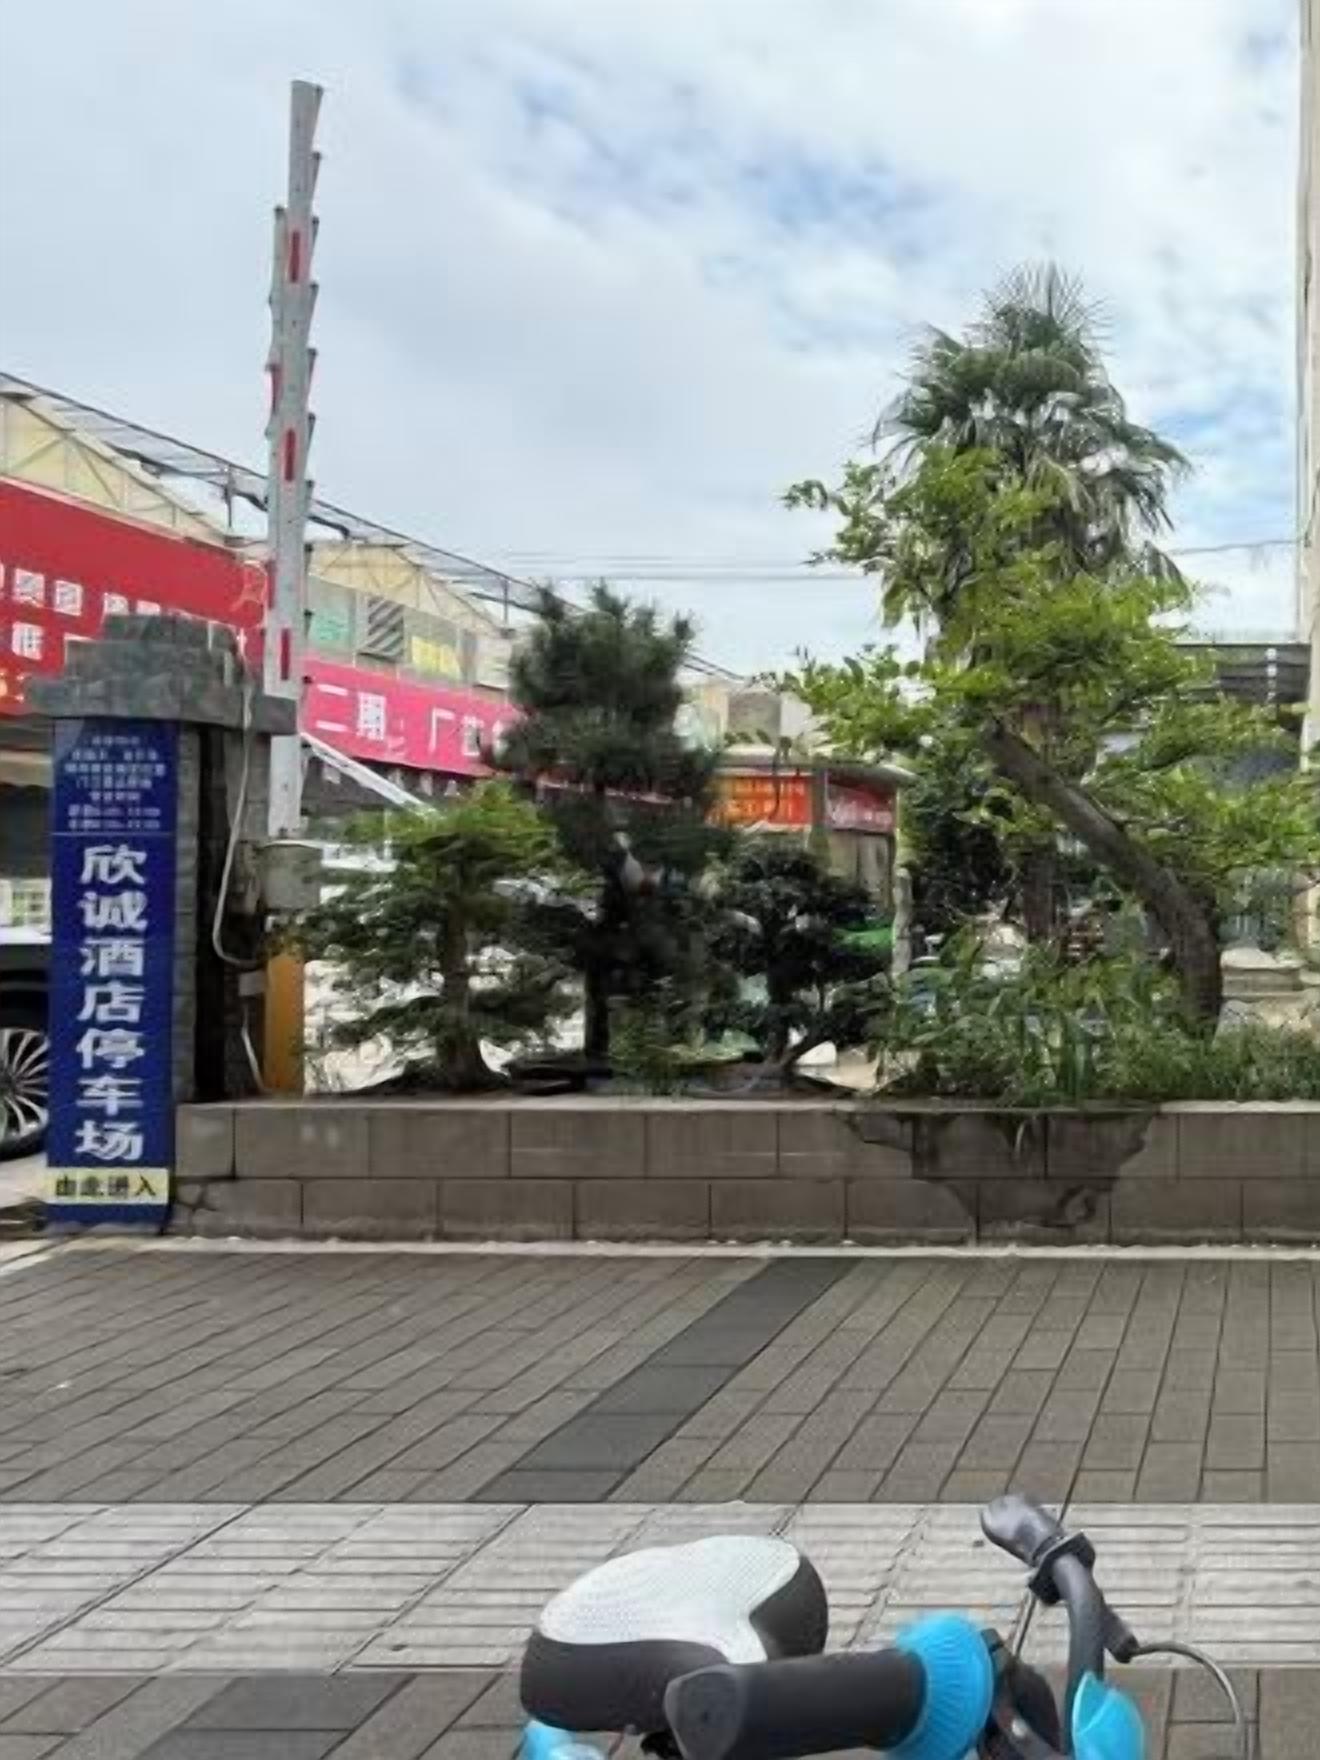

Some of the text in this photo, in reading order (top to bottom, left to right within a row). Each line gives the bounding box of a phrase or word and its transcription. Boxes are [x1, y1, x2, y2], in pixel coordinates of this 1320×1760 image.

[75, 844, 148, 1160] 欣诚酒店停车场
